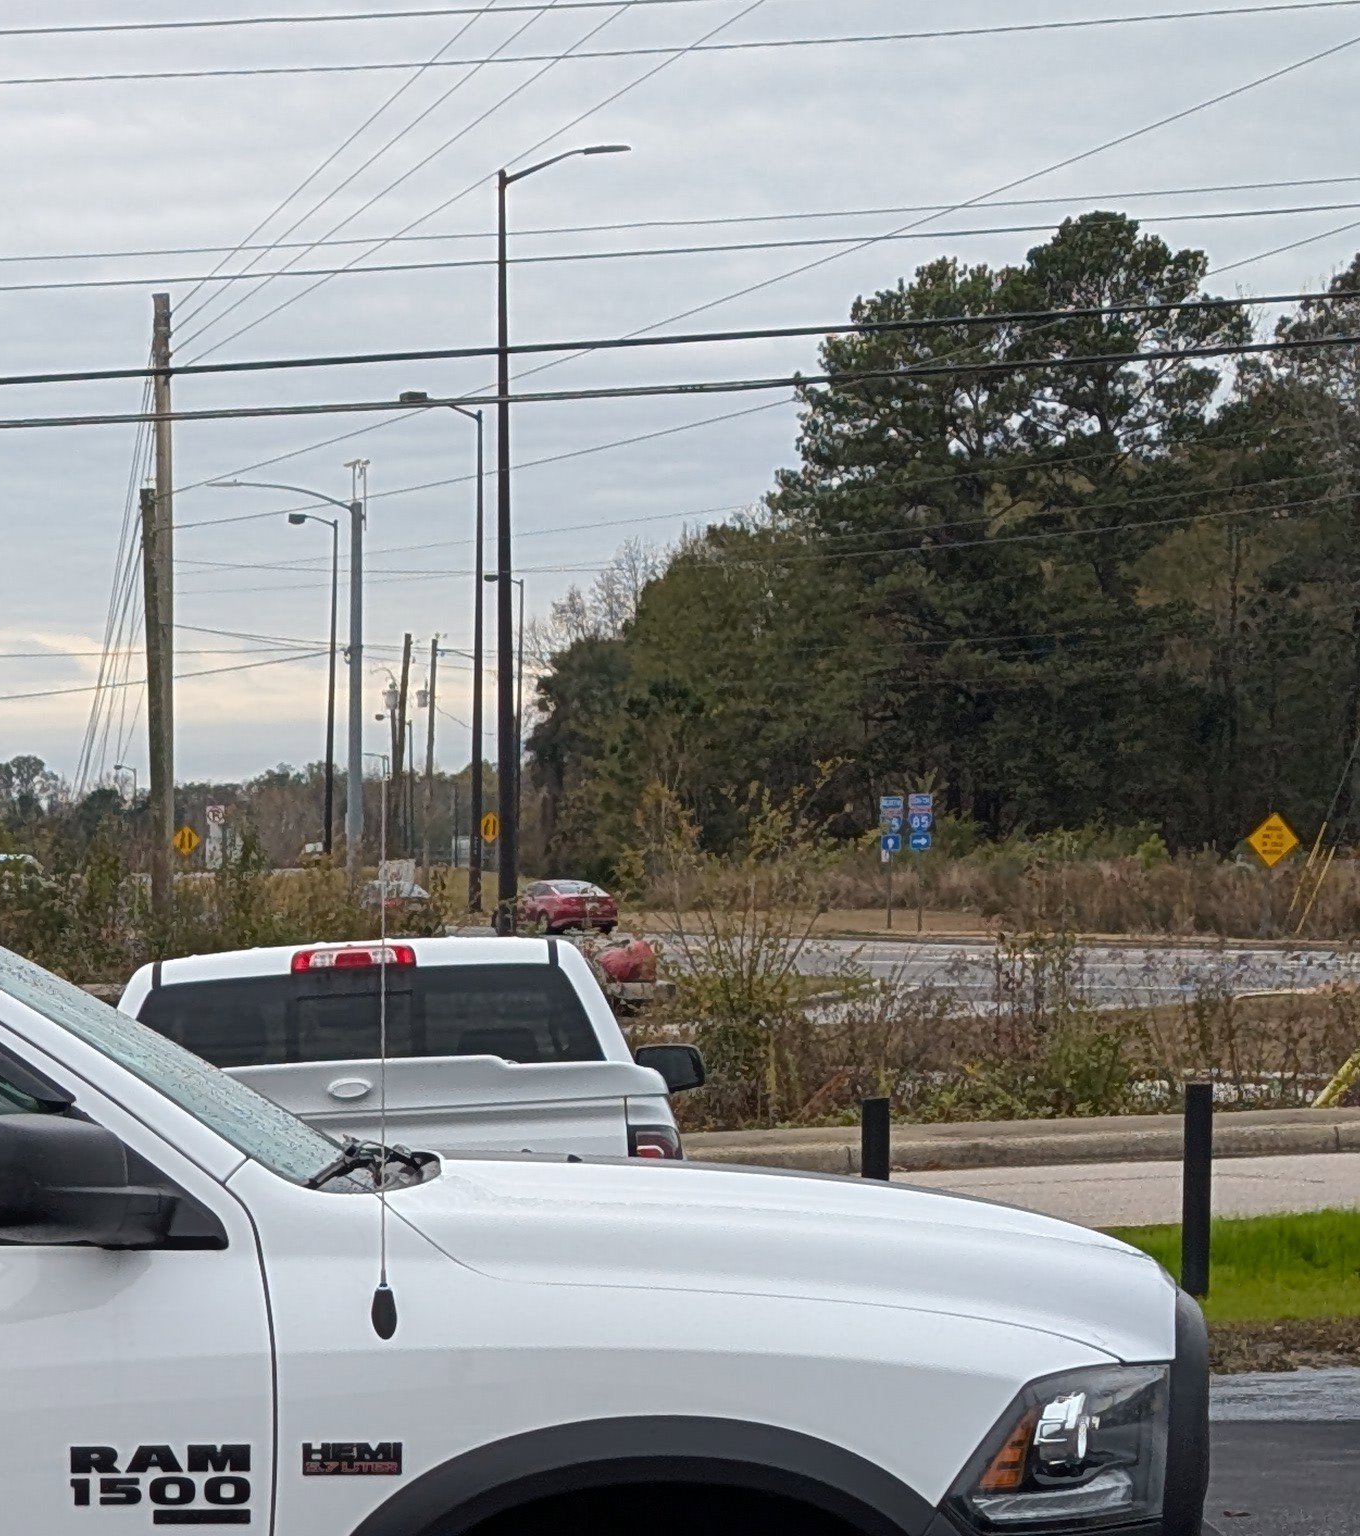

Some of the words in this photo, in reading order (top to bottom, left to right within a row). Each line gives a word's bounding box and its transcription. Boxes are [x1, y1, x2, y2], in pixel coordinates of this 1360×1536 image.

[70, 1443, 251, 1474] RAM
[302, 1442, 402, 1461] HEMI
[70, 1476, 251, 1506] 1500
